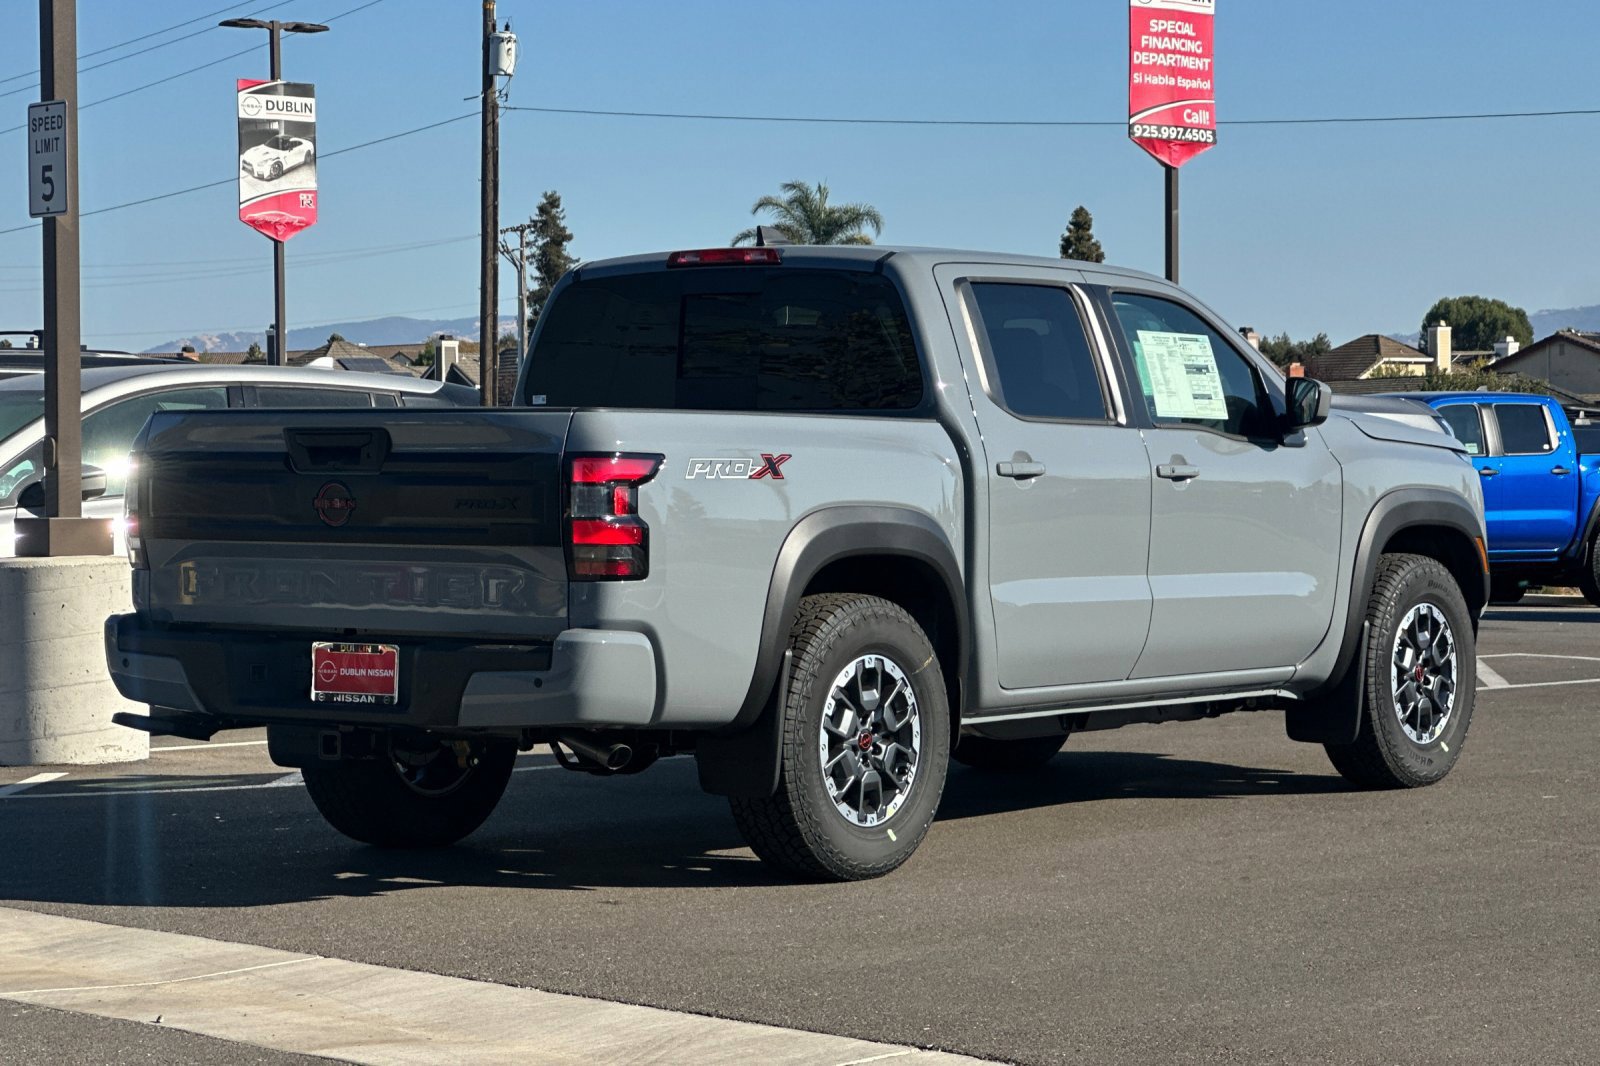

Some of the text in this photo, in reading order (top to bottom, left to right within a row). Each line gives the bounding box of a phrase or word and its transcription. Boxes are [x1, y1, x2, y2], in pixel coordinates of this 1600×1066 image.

[1149, 19, 1196, 36] SPECIAL
[1141, 35, 1203, 54] FINANCING
[1133, 51, 1211, 71] DEPARTMENT
[1144, 73, 1175, 86] Habla
[1177, 76, 1211, 90] Español
[266, 99, 313, 114] DUBLIN
[31, 115, 63, 132] SPEED
[1183, 109, 1210, 125] Call!
[1133, 124, 1214, 143] 925.997.4505
[35, 137, 60, 154] LIMIT
[41, 164, 55, 202] 5
[685, 453, 792, 480] PRO-X
[340, 667, 394, 677] DUBLIN NISSAN
[333, 694, 376, 703] NISSAN
